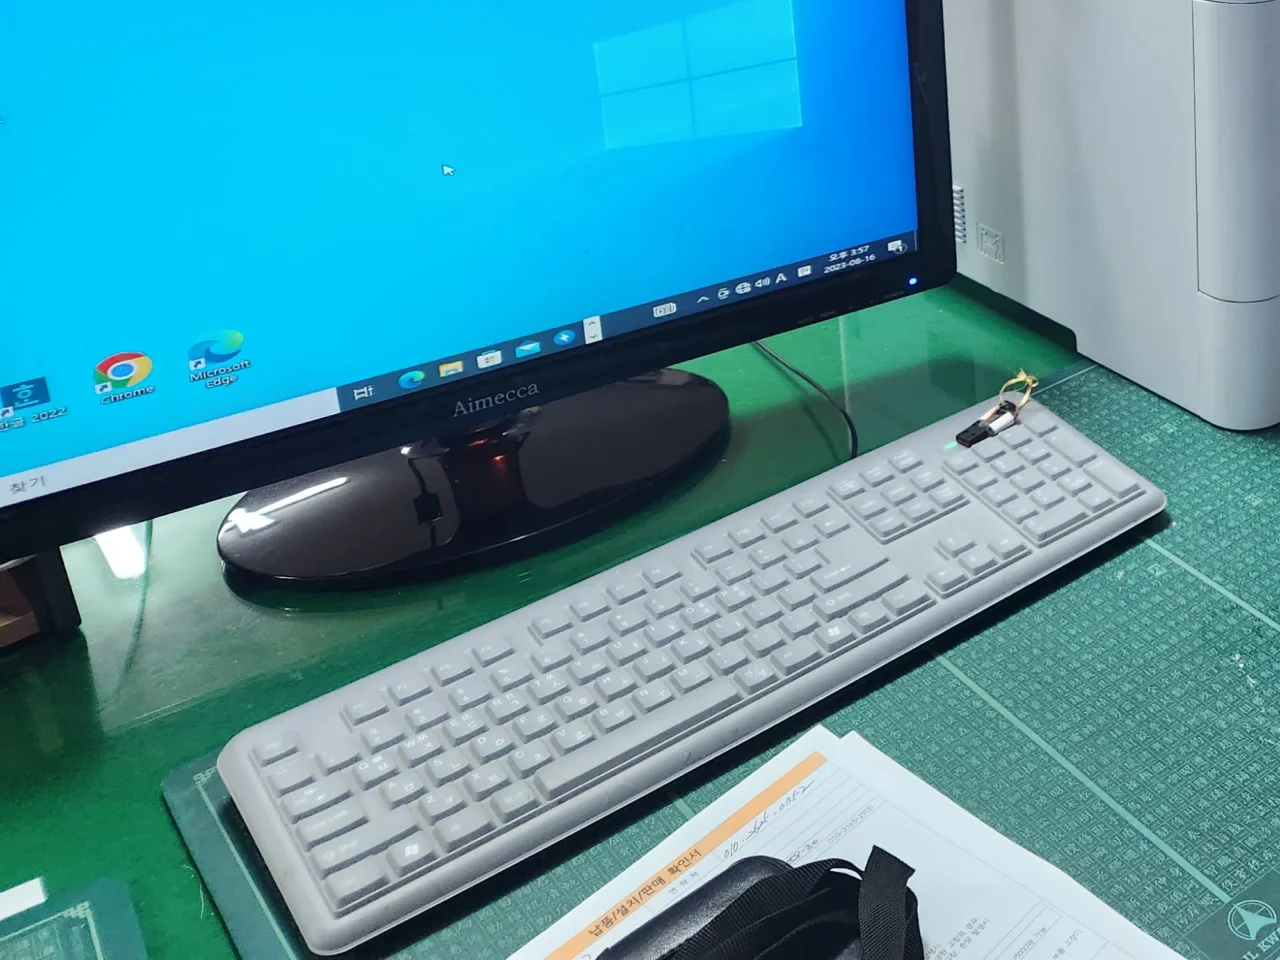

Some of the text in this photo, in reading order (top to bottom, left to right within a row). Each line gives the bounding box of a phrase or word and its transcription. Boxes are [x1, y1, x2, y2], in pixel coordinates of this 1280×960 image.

[824, 253, 876, 274] 2023-08-16
[828, 245, 870, 263] 오후 3:57
[189, 359, 251, 382] Microsoft
[206, 374, 238, 388] Edge
[101, 385, 155, 405] Chrome
[452, 383, 540, 418] Aimecca
[31, 407, 67, 423] 2022
[9, 475, 46, 495] 찾기
[588, 848, 702, 938] 납품/설치/판매 확인서
